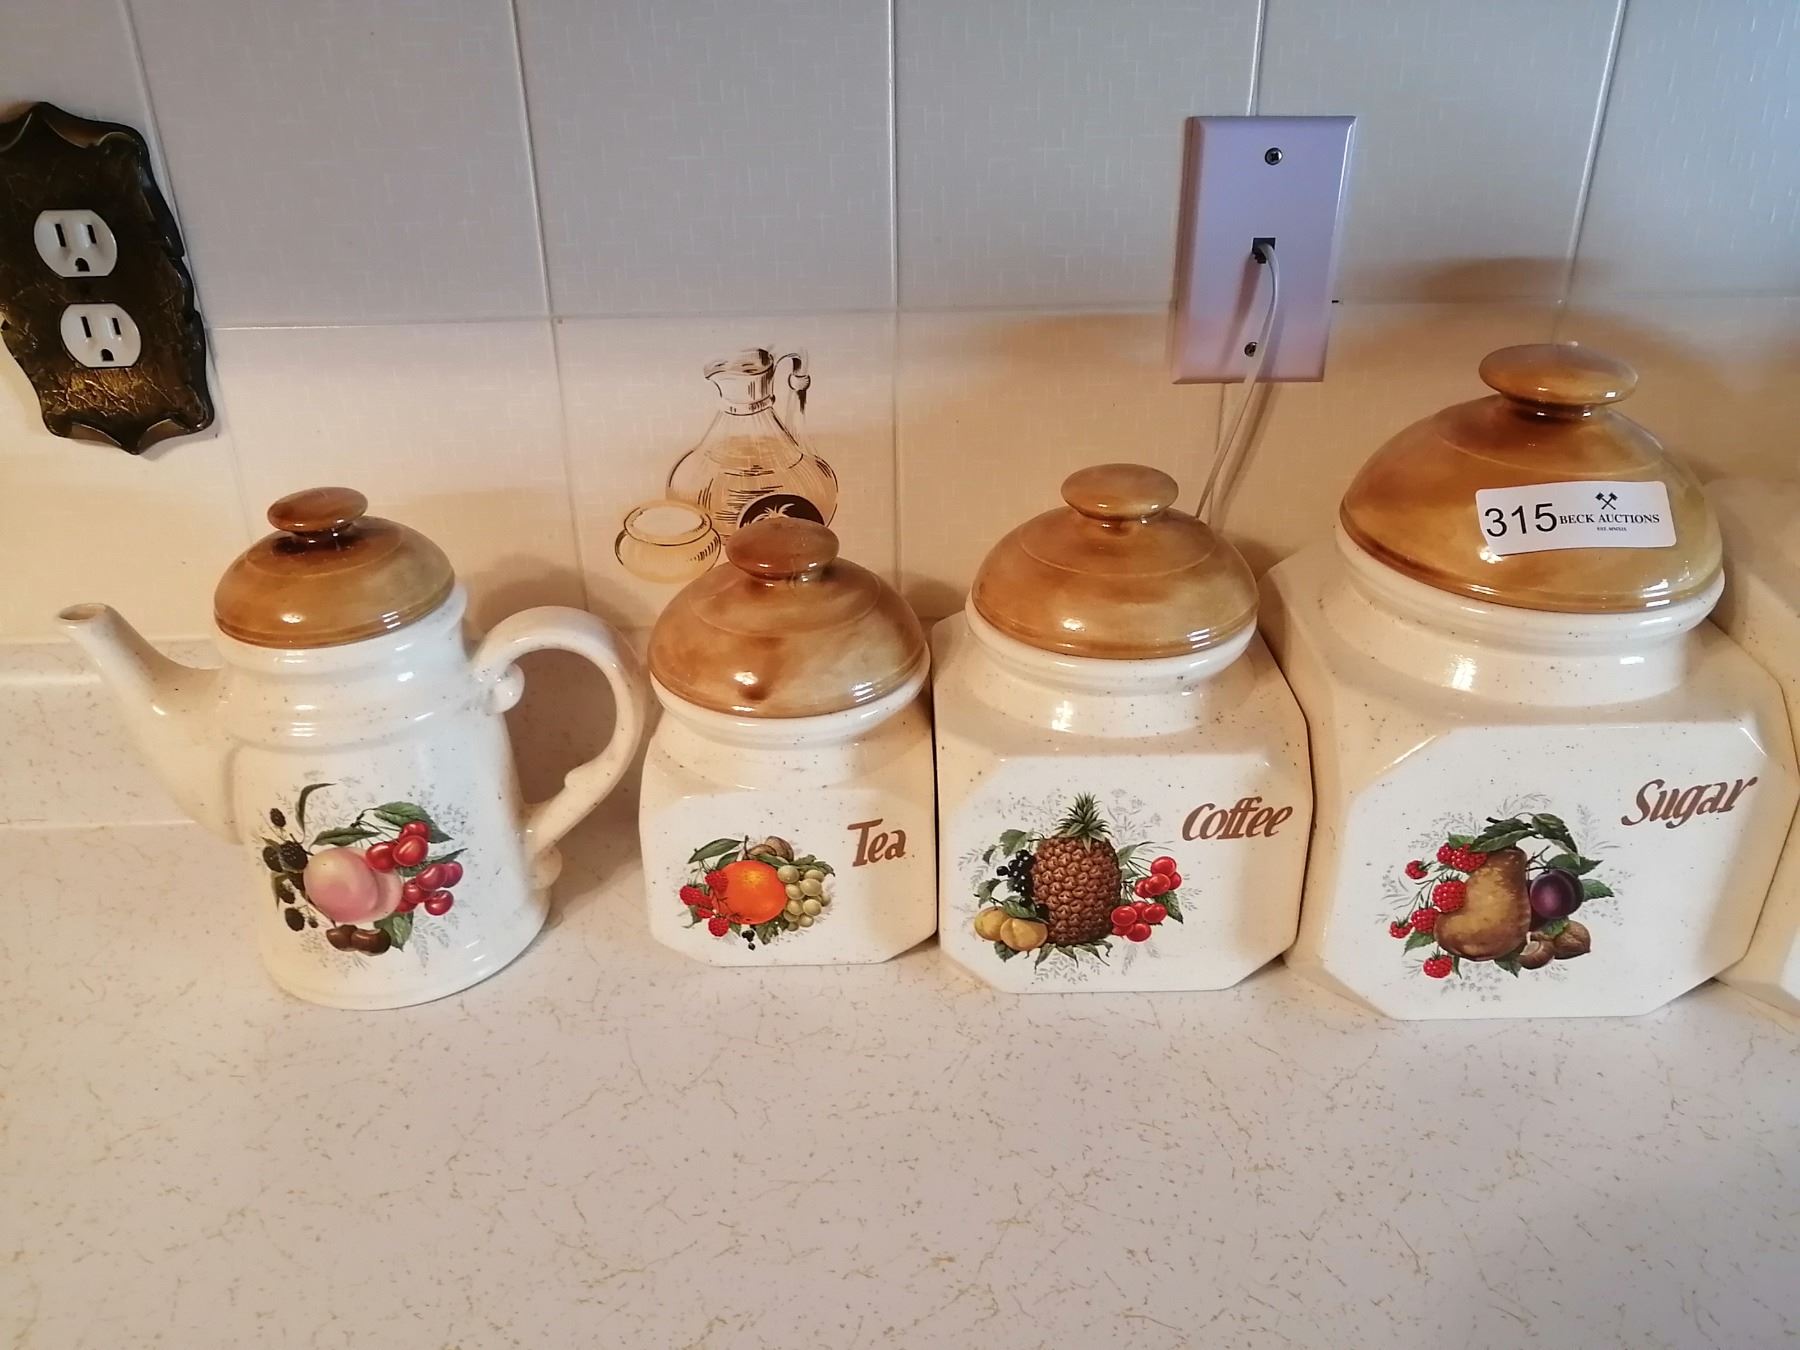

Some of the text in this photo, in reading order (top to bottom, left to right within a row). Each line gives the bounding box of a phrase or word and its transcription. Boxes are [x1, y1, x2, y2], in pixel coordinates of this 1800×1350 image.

[1484, 502, 1558, 538] 315
[1559, 513, 1660, 525] BECK AUCTIONS
[1181, 796, 1293, 841] Coffee
[1620, 776, 1758, 829] Sugar
[847, 818, 906, 867] Tea
